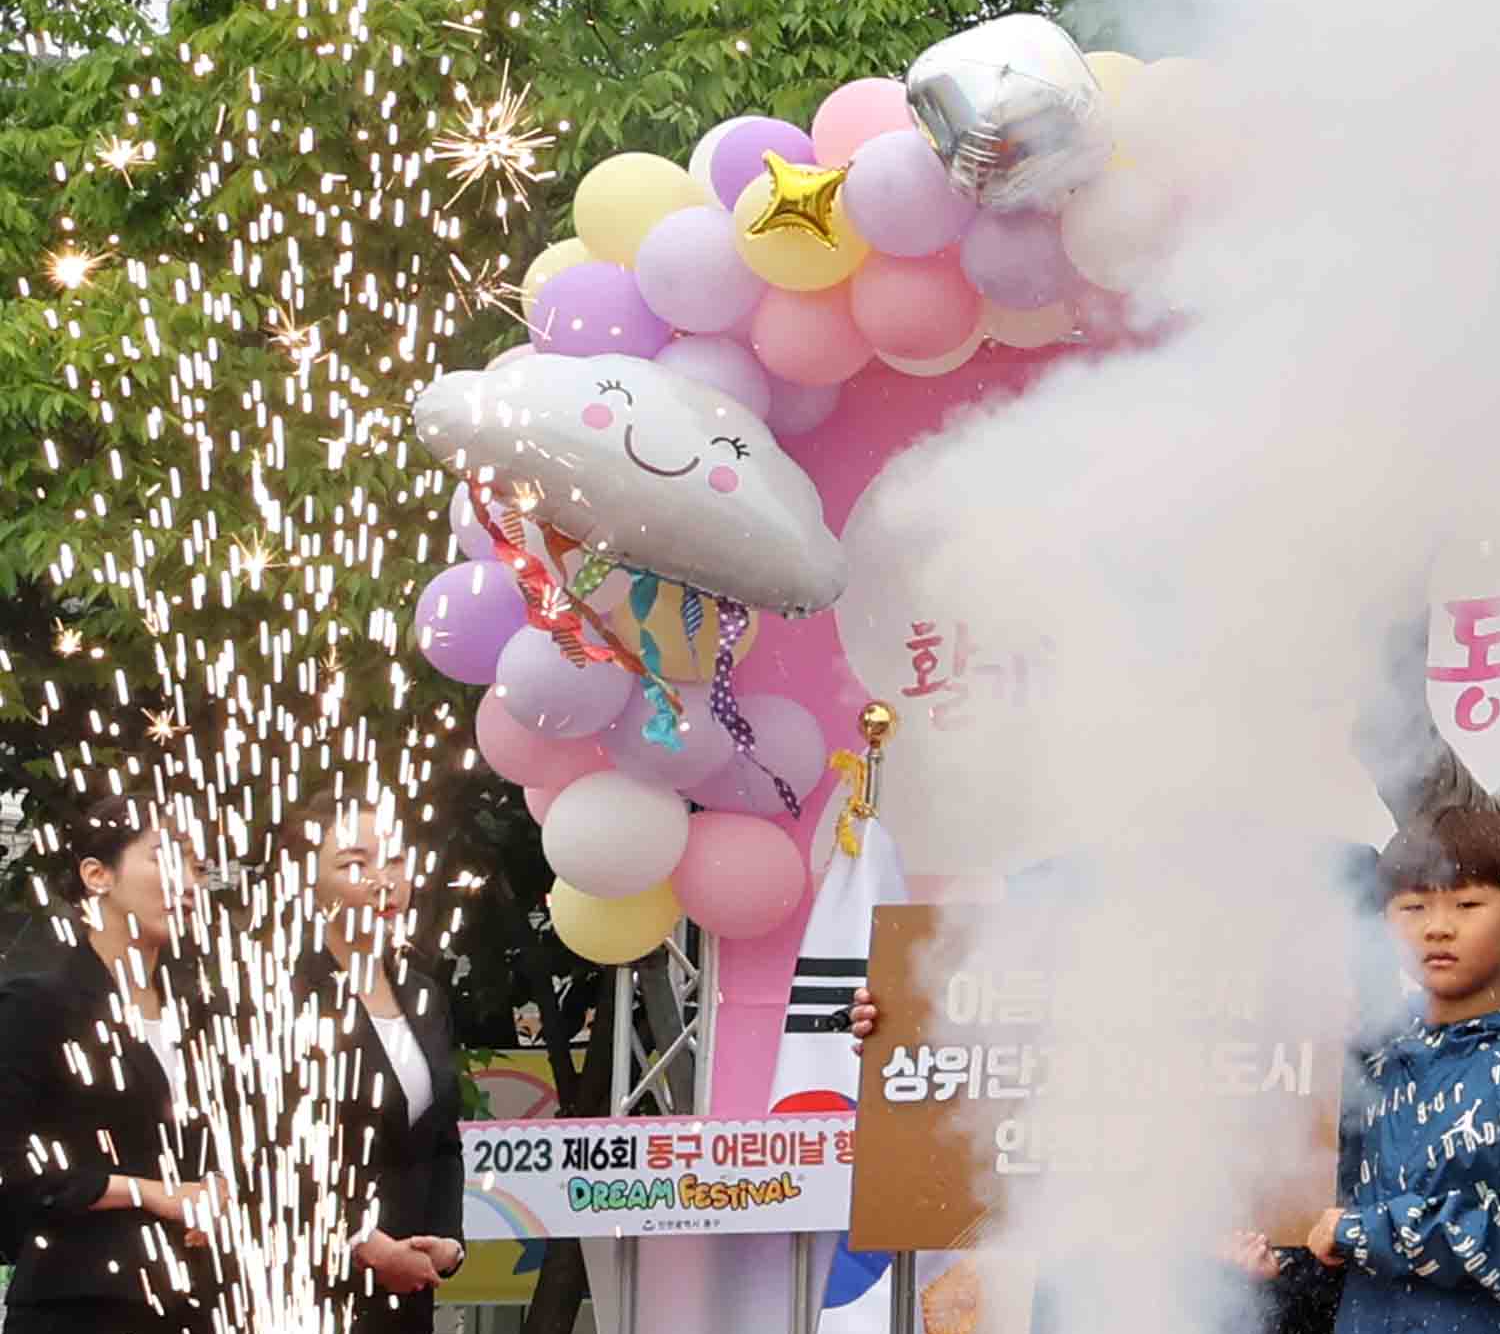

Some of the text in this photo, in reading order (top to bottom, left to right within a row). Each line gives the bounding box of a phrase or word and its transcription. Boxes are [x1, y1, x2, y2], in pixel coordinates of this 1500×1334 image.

[473, 1139, 552, 1173] 2023
[562, 1136, 637, 1170] 제6회
[646, 1134, 704, 1168] 동구
[712, 1131, 827, 1166] 어린이날
[569, 1176, 674, 1213] DREAM
